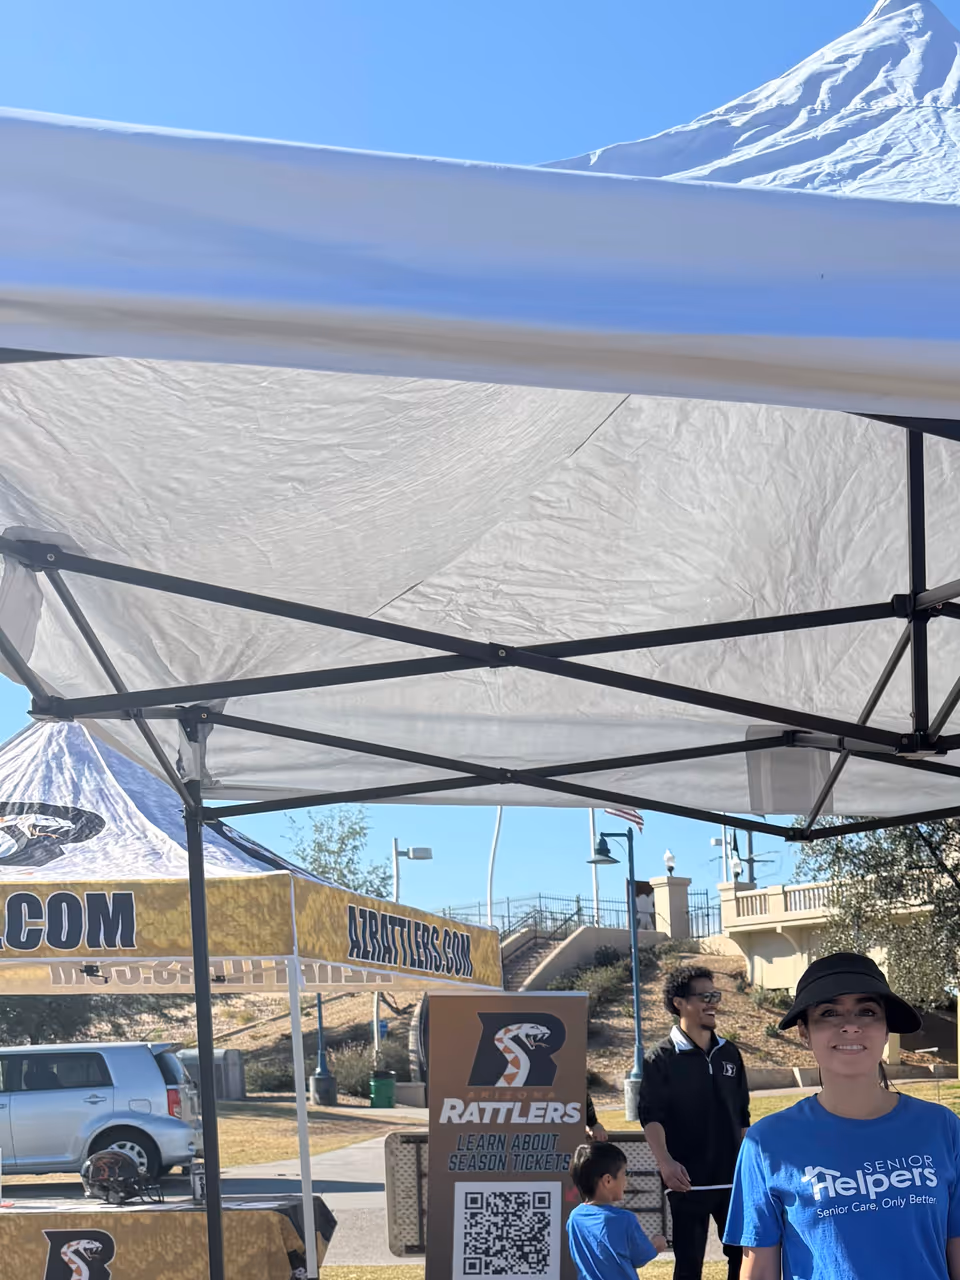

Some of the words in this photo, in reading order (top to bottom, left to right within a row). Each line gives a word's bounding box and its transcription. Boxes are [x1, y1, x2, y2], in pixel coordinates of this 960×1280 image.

[347, 904, 473, 979] AZRATTLERS.COM
[439, 1098, 581, 1124] RATTLERS
[457, 1132, 507, 1151] LEARN
[511, 1132, 560, 1151] ABOUT
[449, 1152, 507, 1172] SEASON
[513, 1153, 571, 1172] TICKETS
[864, 1155, 933, 1173] SENIOR
[811, 1167, 938, 1200] Helpers
[817, 1206, 849, 1218] Senior
[852, 1202, 879, 1212] Care,
[882, 1196, 906, 1208] Only
